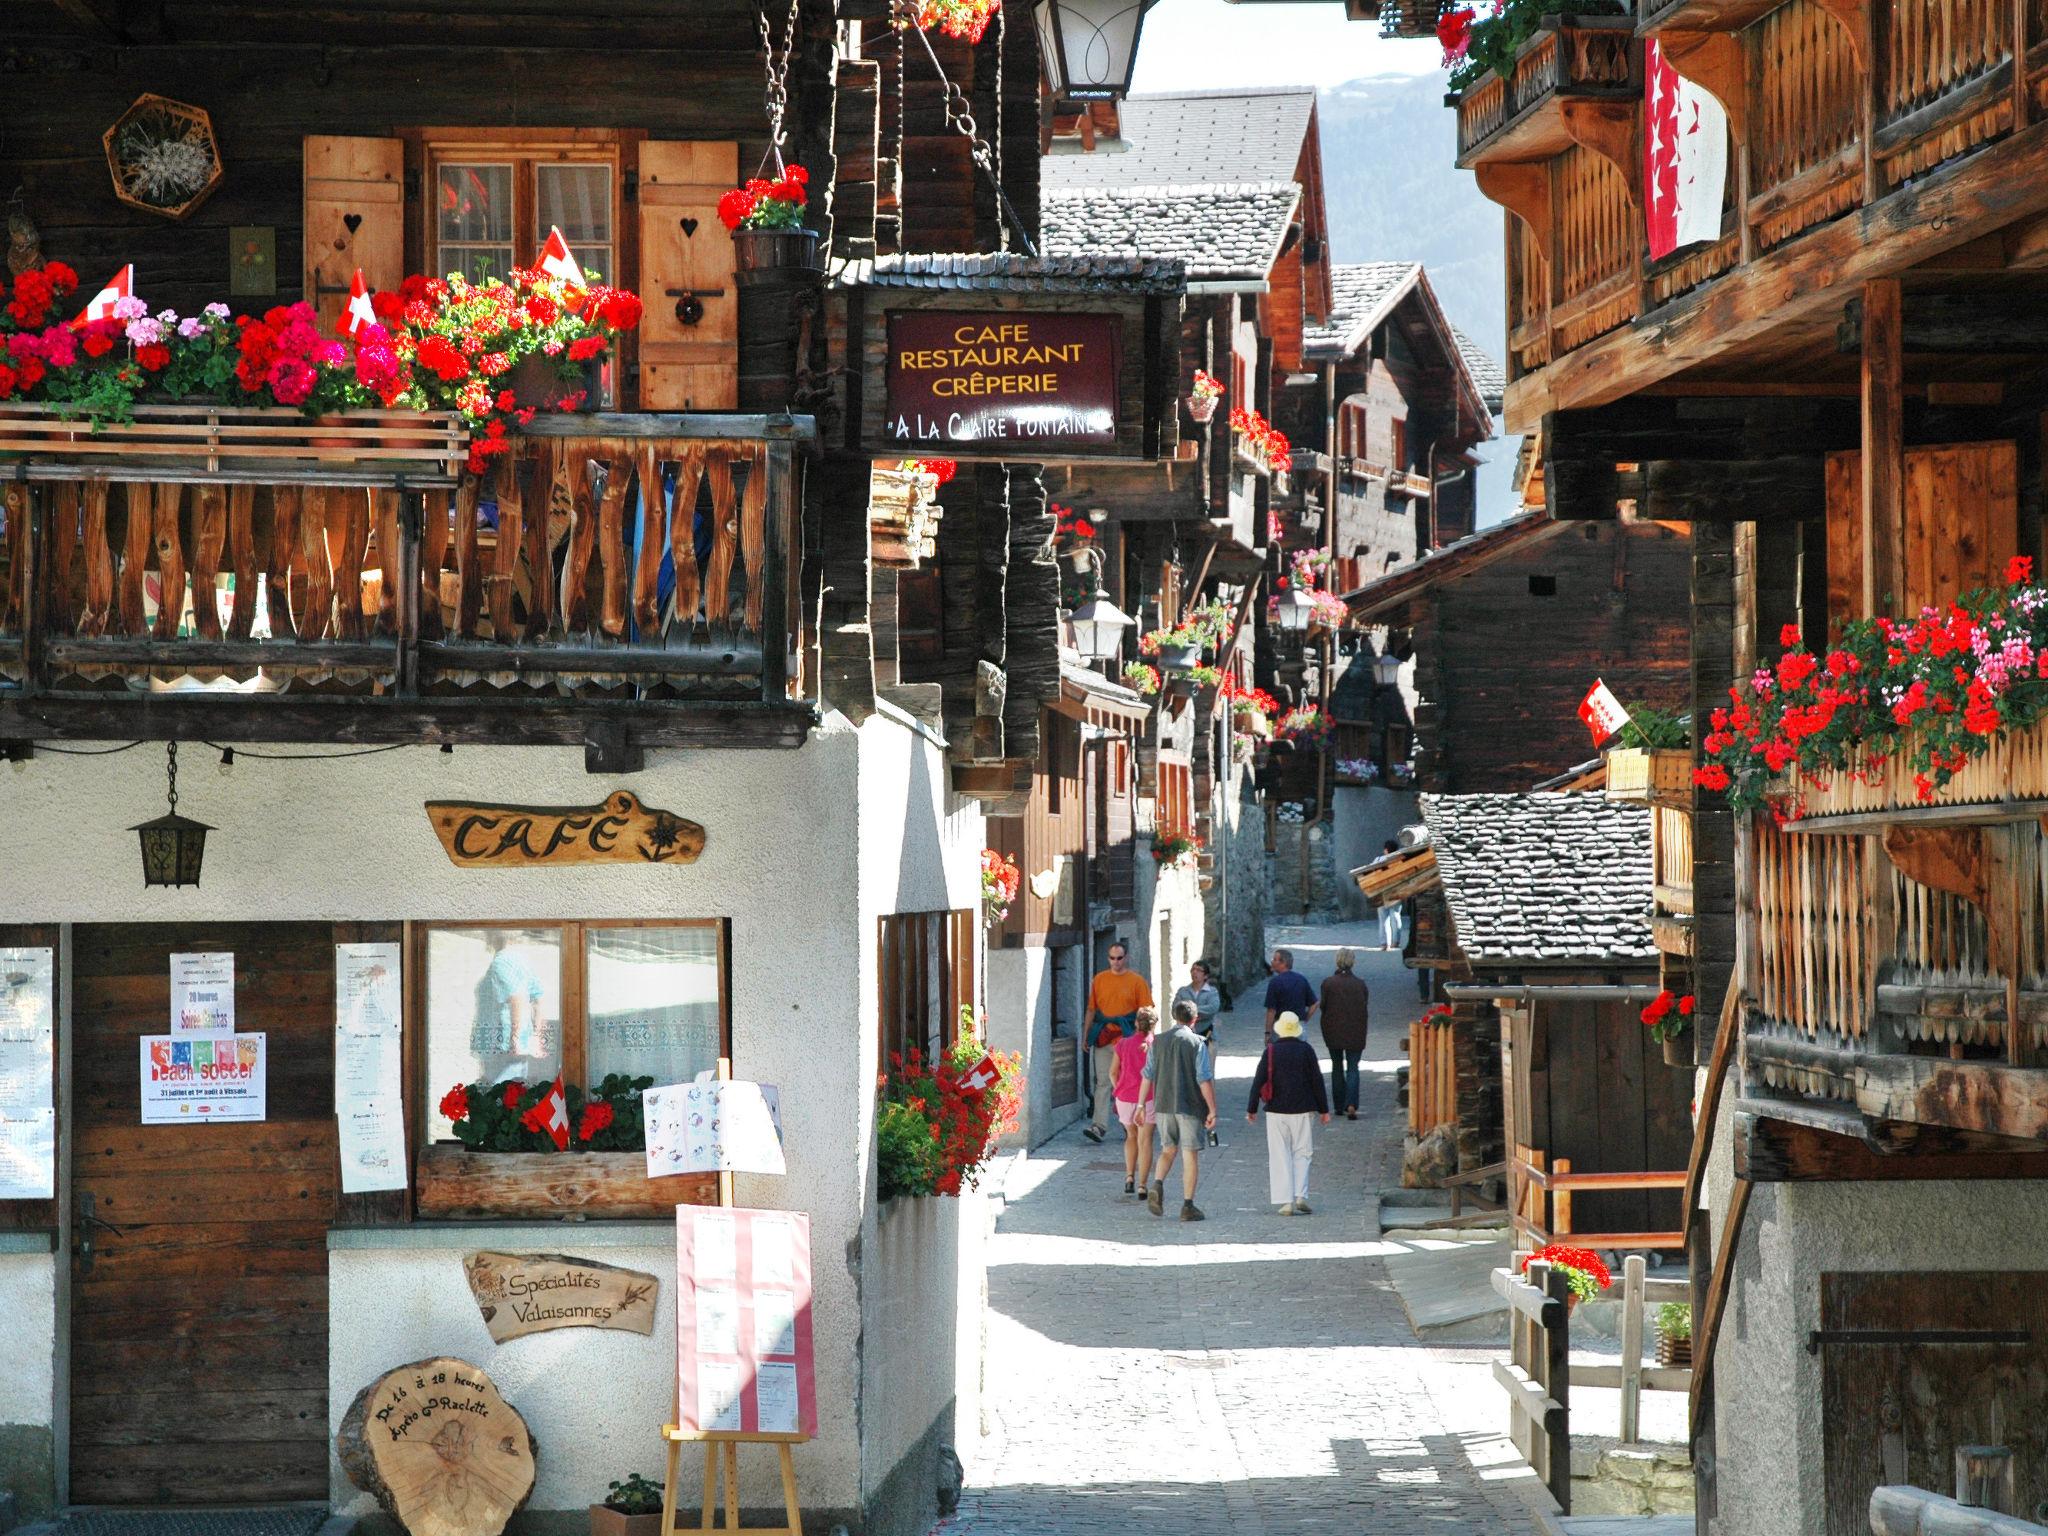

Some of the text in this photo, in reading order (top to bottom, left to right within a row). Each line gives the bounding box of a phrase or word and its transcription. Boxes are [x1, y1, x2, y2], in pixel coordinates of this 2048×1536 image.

[954, 324, 1029, 345] CAFE
[900, 344, 1083, 369] RESTAURANT
[932, 371, 1058, 396] CRÊPERIE
[151, 1061, 255, 1081] beach soccer
[160, 1088, 169, 1097] 31
[508, 1270, 601, 1301] Spécialités
[511, 1301, 612, 1323] Valaisannes
[375, 1371, 486, 1424] De 16 à 18 heures
[439, 1396, 489, 1418] Raclette
